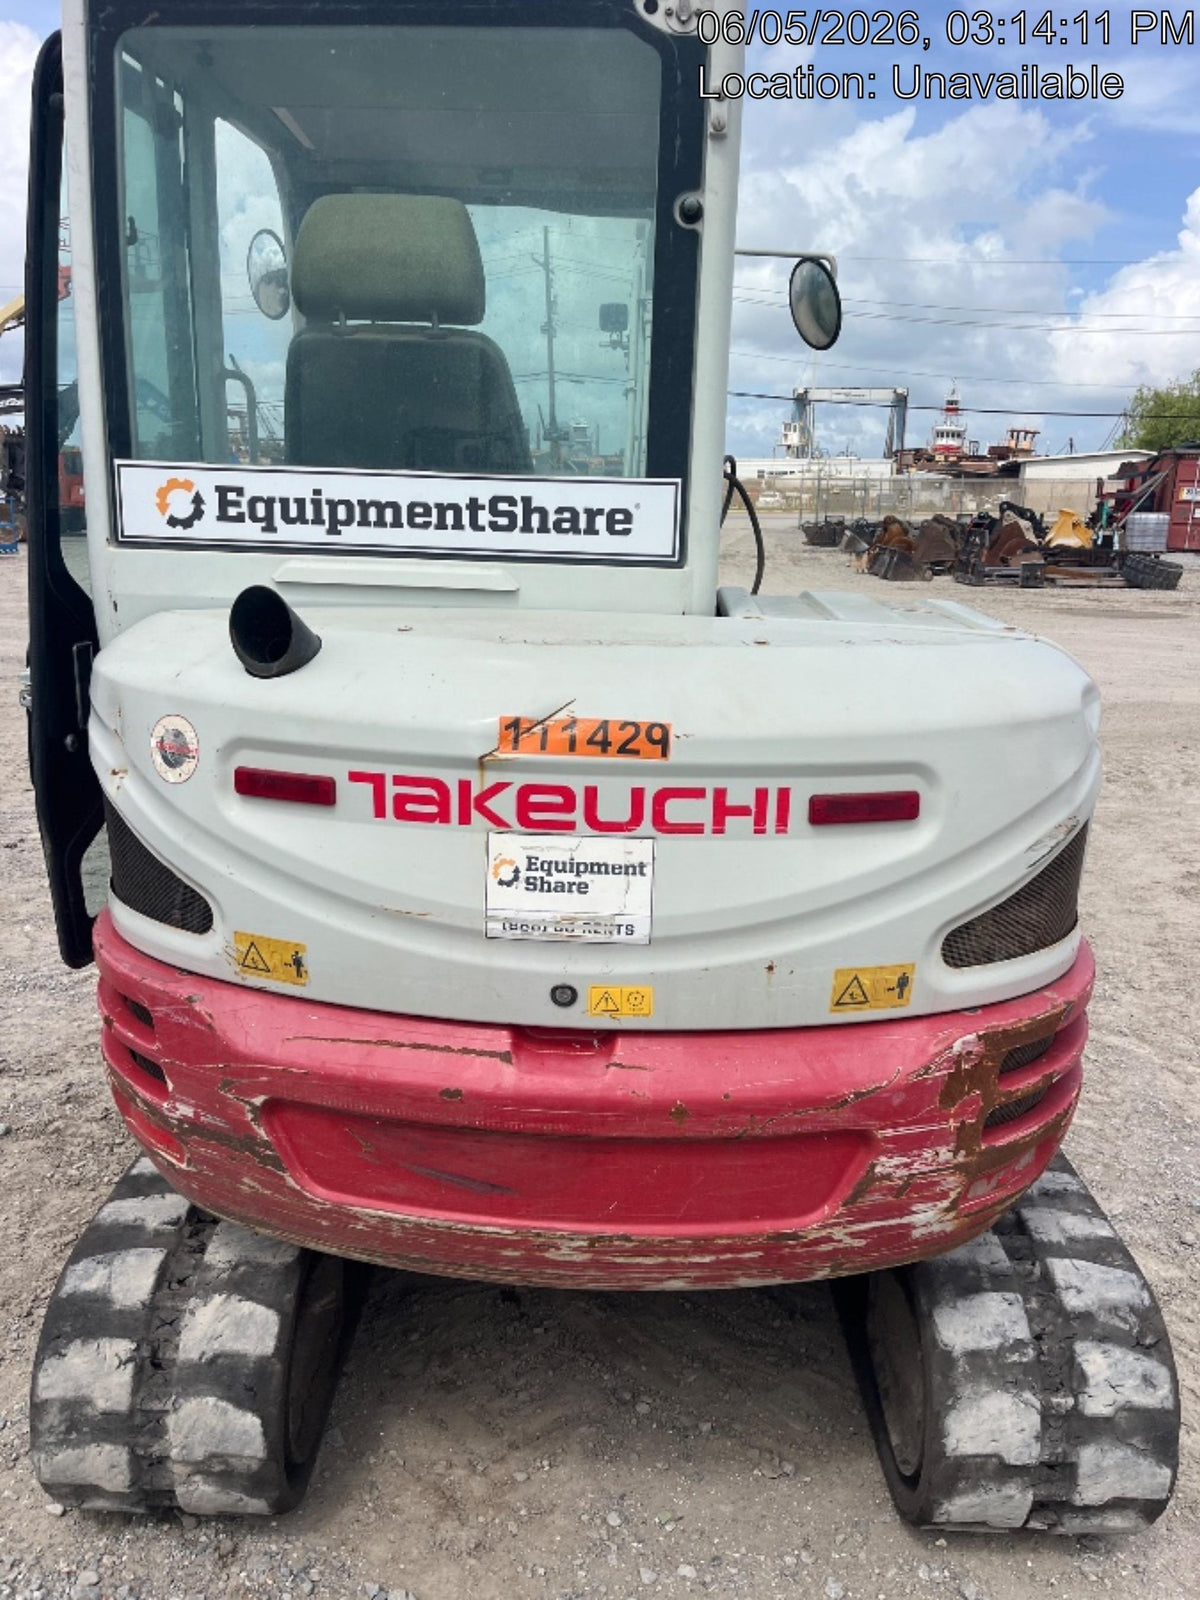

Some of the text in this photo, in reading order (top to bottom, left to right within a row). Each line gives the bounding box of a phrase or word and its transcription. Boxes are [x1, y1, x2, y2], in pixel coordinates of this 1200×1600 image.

[214, 484, 634, 537] EquipmentShare
[504, 716, 669, 758] 111429
[525, 855, 647, 877] Equipment
[524, 876, 589, 895] Share
